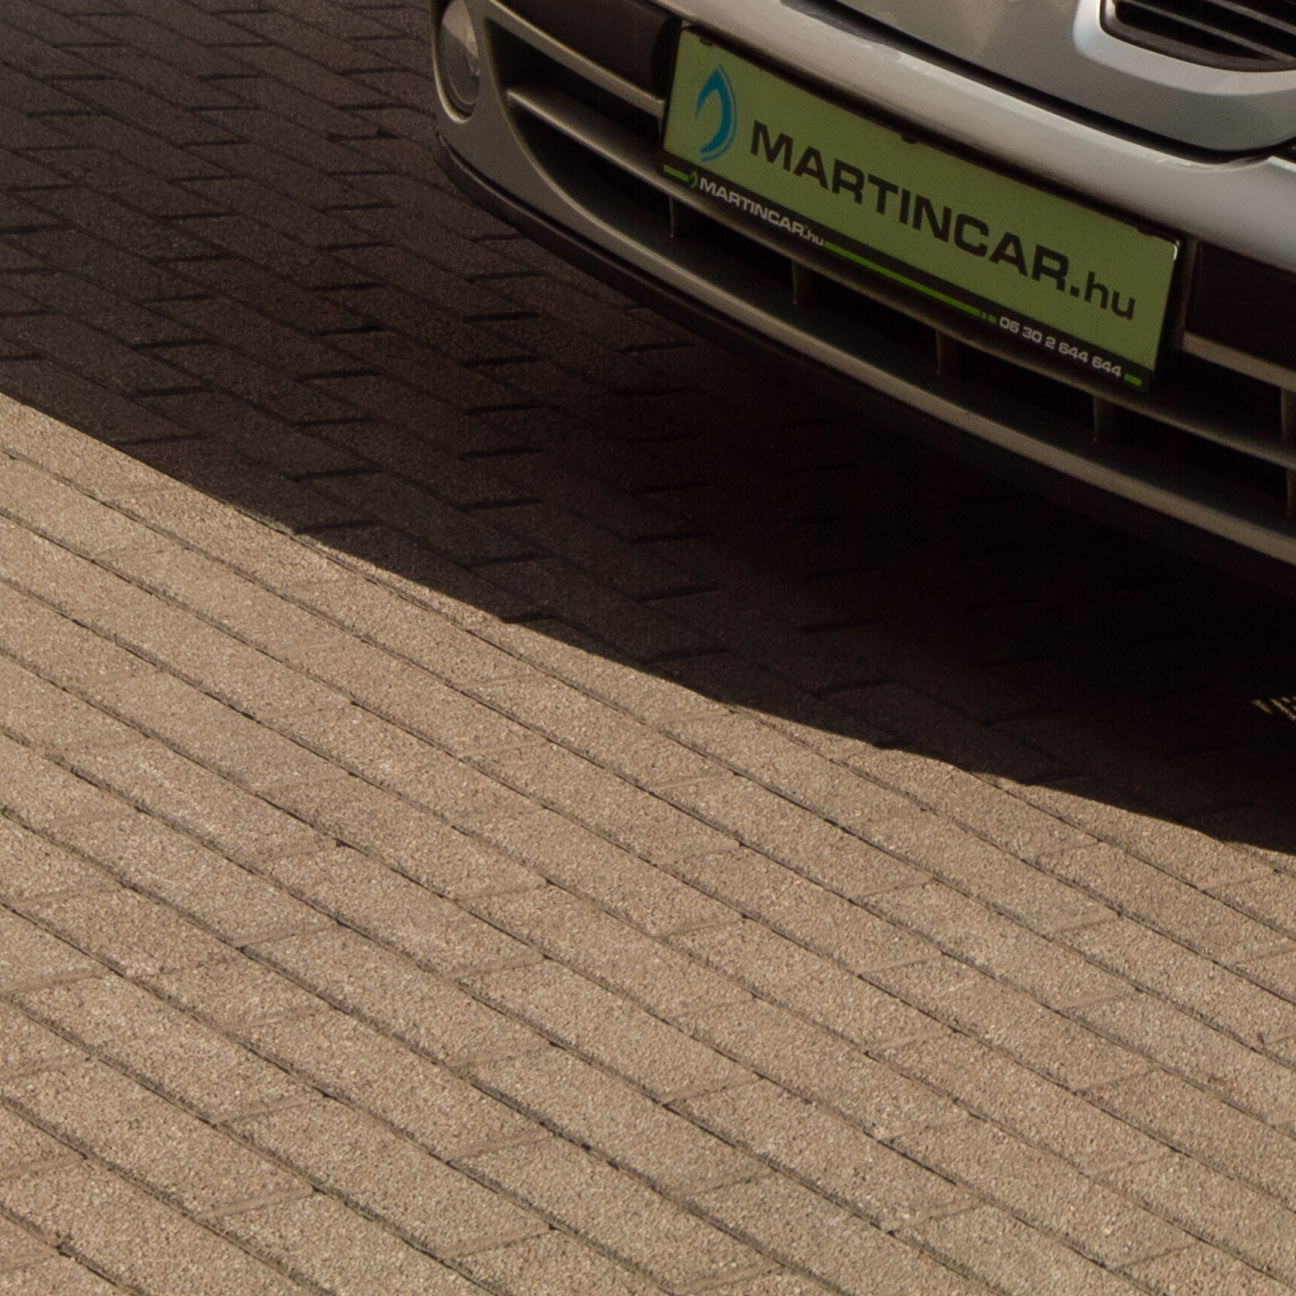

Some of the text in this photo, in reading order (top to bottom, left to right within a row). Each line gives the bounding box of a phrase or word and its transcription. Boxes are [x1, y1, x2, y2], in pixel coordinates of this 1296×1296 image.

[699, 177, 824, 247] MARTINCAR.hu
[750, 120, 1136, 321] MARTINCAR.hu
[1000, 316, 1122, 378] 06 30 2 644 644
